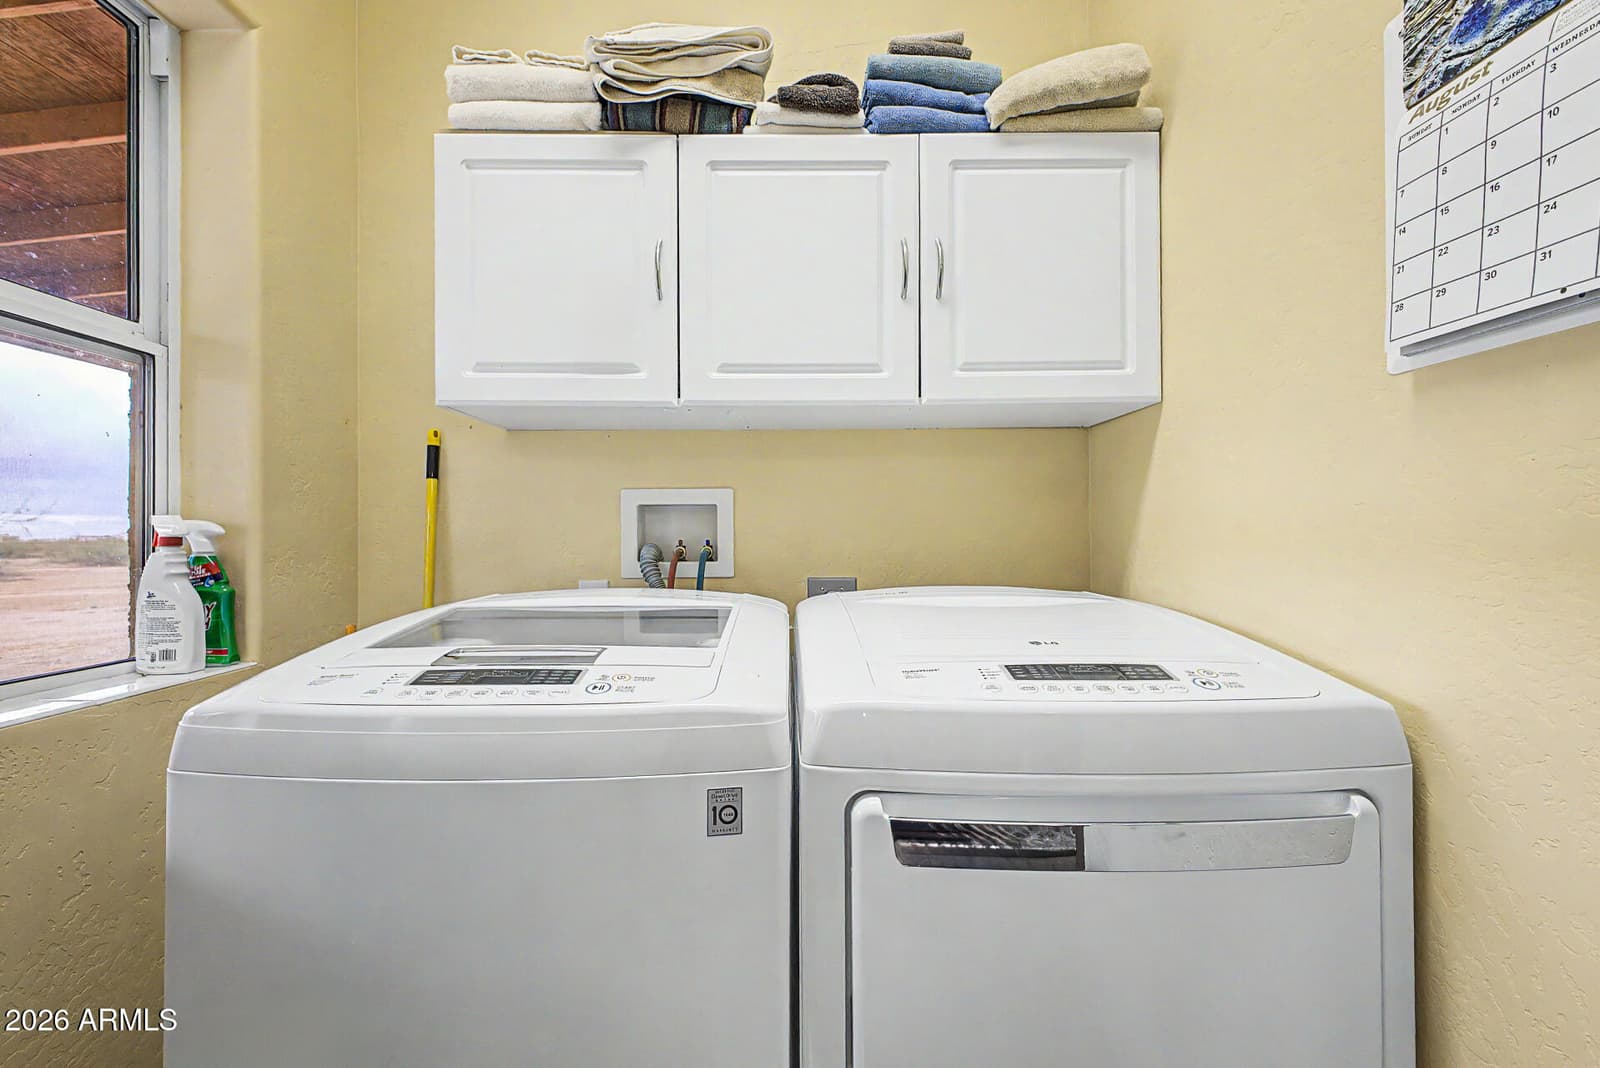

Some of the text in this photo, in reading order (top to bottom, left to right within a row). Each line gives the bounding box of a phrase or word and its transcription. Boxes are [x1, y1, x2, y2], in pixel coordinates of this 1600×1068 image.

[1407, 123, 1433, 142] SUNDAY
[1451, 93, 1481, 114] MONDAY
[1500, 59, 1536, 85] TUESDAY
[1408, 60, 1494, 125] August
[1444, 62, 1557, 135] 1 2 3
[1400, 106, 1560, 198] 7 8 9 10
[1398, 154, 1558, 236] 14 15 16 17
[1396, 200, 1557, 274] 21 22 23 24
[1394, 249, 1553, 313] 28 29 30 31
[711, 804, 738, 826] 10
